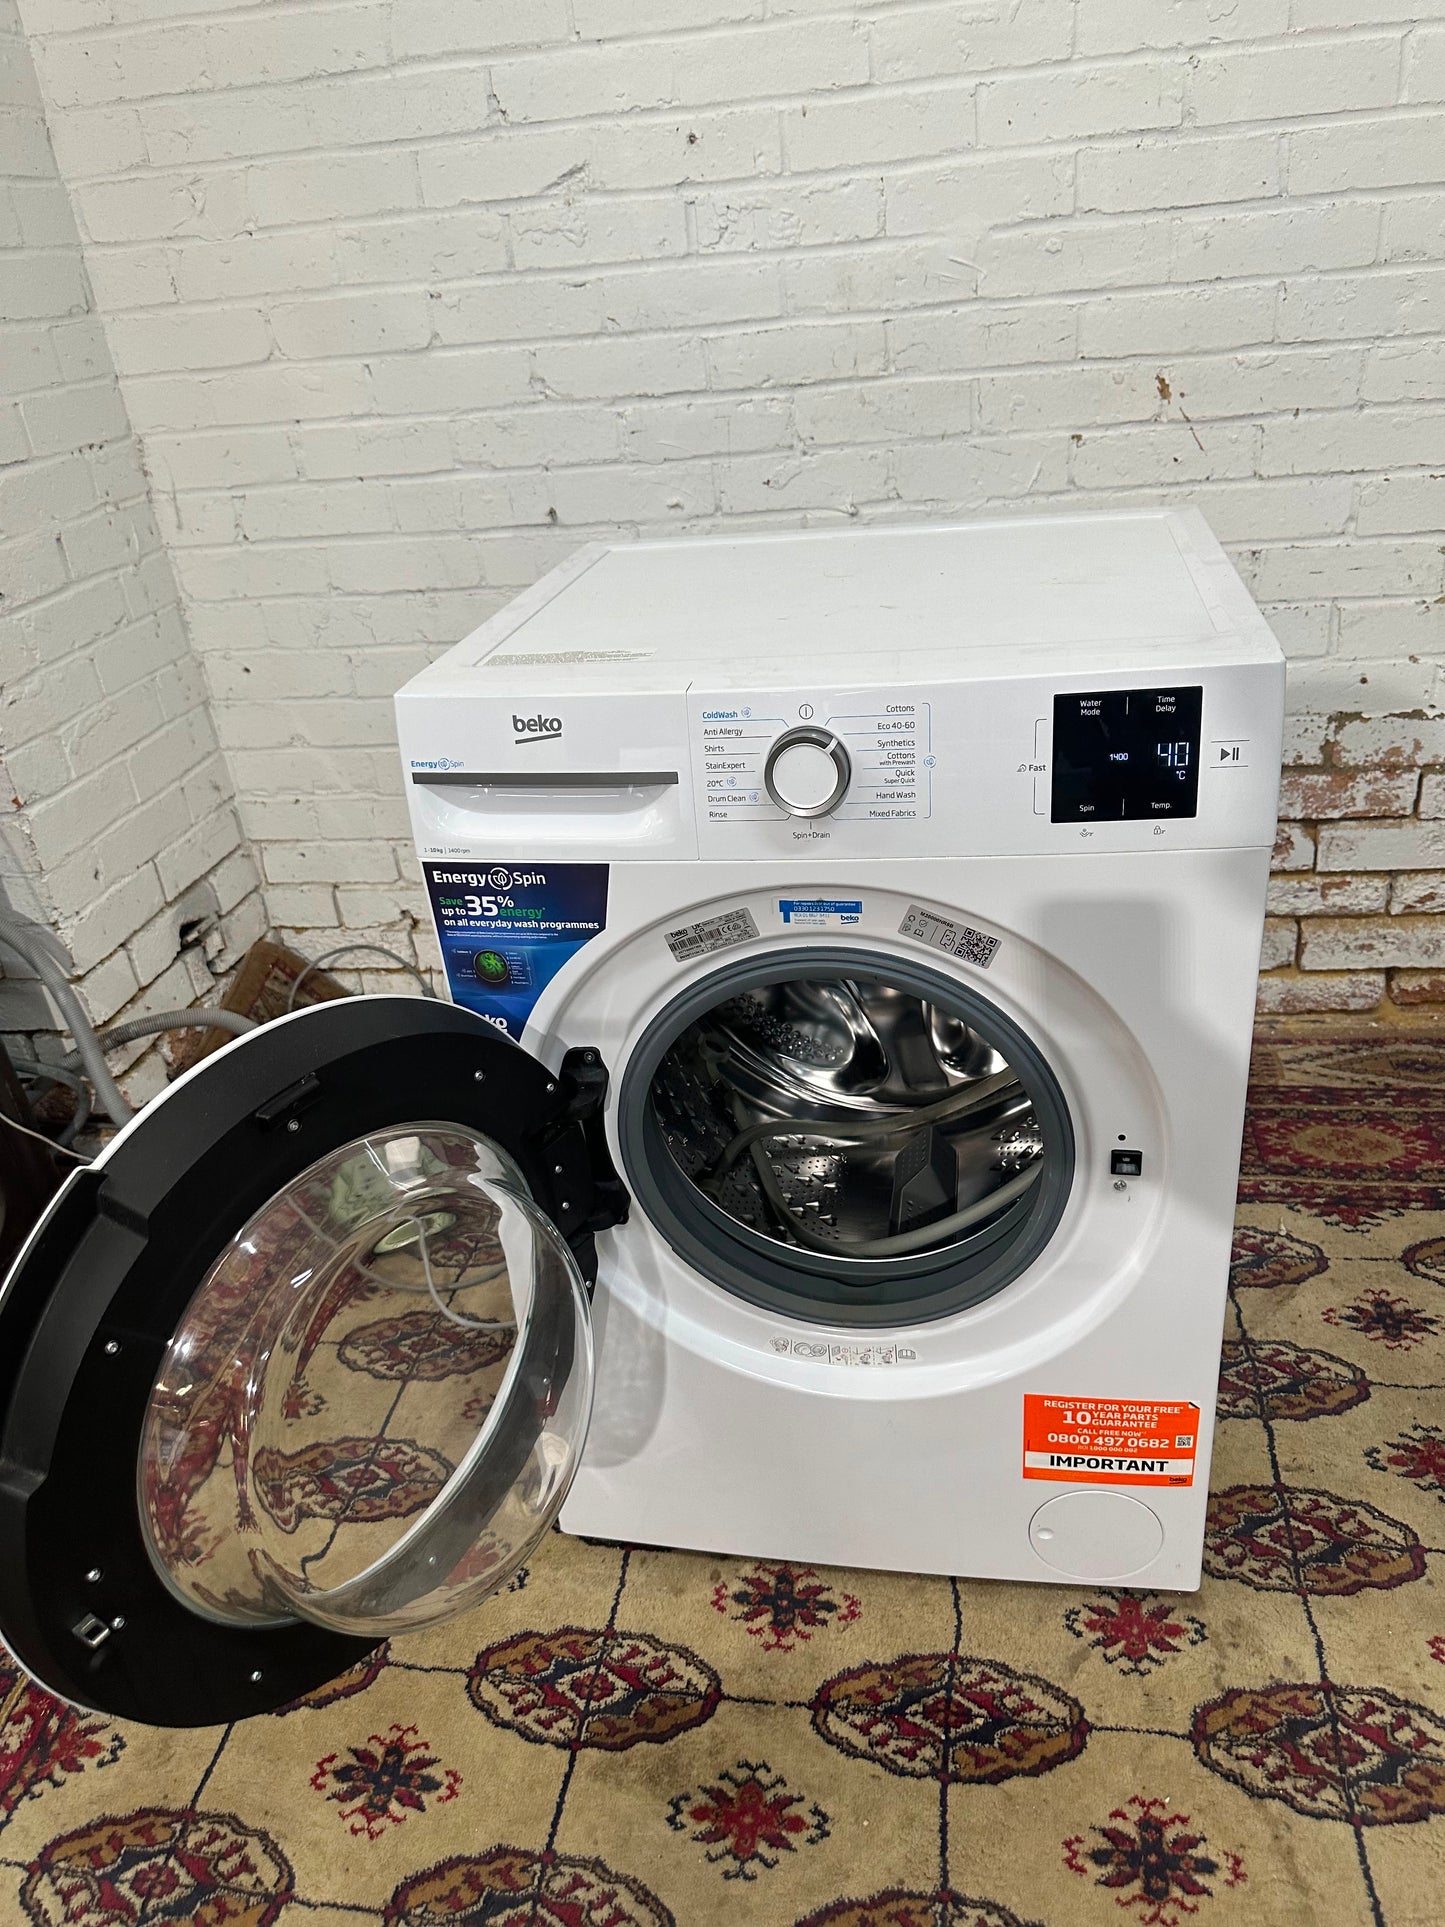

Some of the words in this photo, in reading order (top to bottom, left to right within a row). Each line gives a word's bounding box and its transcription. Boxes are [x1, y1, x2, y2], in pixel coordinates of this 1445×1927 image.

[1079, 699, 1102, 708] Water
[1157, 695, 1175, 703] Time
[885, 704, 915, 713] Cottons
[1080, 708, 1101, 716] Mode
[1155, 704, 1176, 713] Delay
[702, 711, 738, 719] ColdWash
[512, 714, 563, 733] beko
[877, 722, 890, 730] Eco
[890, 721, 916, 730] 40-60
[703, 728, 718, 736] Anti
[718, 727, 743, 738] Allergy
[704, 744, 725, 753] Shirts
[877, 739, 916, 749] Synthetics
[886, 752, 916, 760] Cottons
[1109, 752, 1129, 761] 1400
[1157, 742, 1189, 767] 40
[411, 760, 438, 769] Energy
[449, 760, 465, 769] Spin
[705, 761, 746, 771] StainExpert
[1028, 763, 1047, 772] Fast
[895, 769, 915, 778] Quick
[900, 777, 915, 785] Quick
[707, 795, 727, 803] Drum
[727, 794, 746, 802] Clean
[876, 792, 893, 800] Hand
[894, 791, 916, 800] Wash
[1079, 804, 1095, 813] Spin
[709, 810, 728, 819] Rinse
[869, 810, 891, 818] Mixed
[892, 809, 917, 818] Fabrics
[432, 870, 486, 887] Energy
[513, 871, 547, 888] Spin
[439, 896, 463, 906] Save
[464, 895, 514, 917] 35%
[441, 907, 454, 917] up
[454, 906, 466, 916] to
[444, 919, 456, 927] on
[457, 918, 469, 927] all
[469, 919, 512, 930] everyday
[513, 919, 538, 928] wash
[540, 920, 600, 931] programmes
[670, 928, 688, 939] beko
[1043, 1400, 1096, 1411] REGISTER
[1097, 1403, 1120, 1412] FOR
[1121, 1404, 1152, 1413] YOUR
[1062, 1410, 1092, 1425] 10
[1093, 1411, 1125, 1420] YEAR
[1127, 1412, 1159, 1421] PARTS
[1092, 1419, 1158, 1429] GUARANTEE
[1077, 1427, 1098, 1435] CALL
[1099, 1429, 1120, 1437] FREE
[1047, 1433, 1091, 1445] 0800
[1093, 1436, 1126, 1447] 497
[1127, 1438, 1170, 1449] 0682
[1049, 1455, 1169, 1472] IMPORTANT
